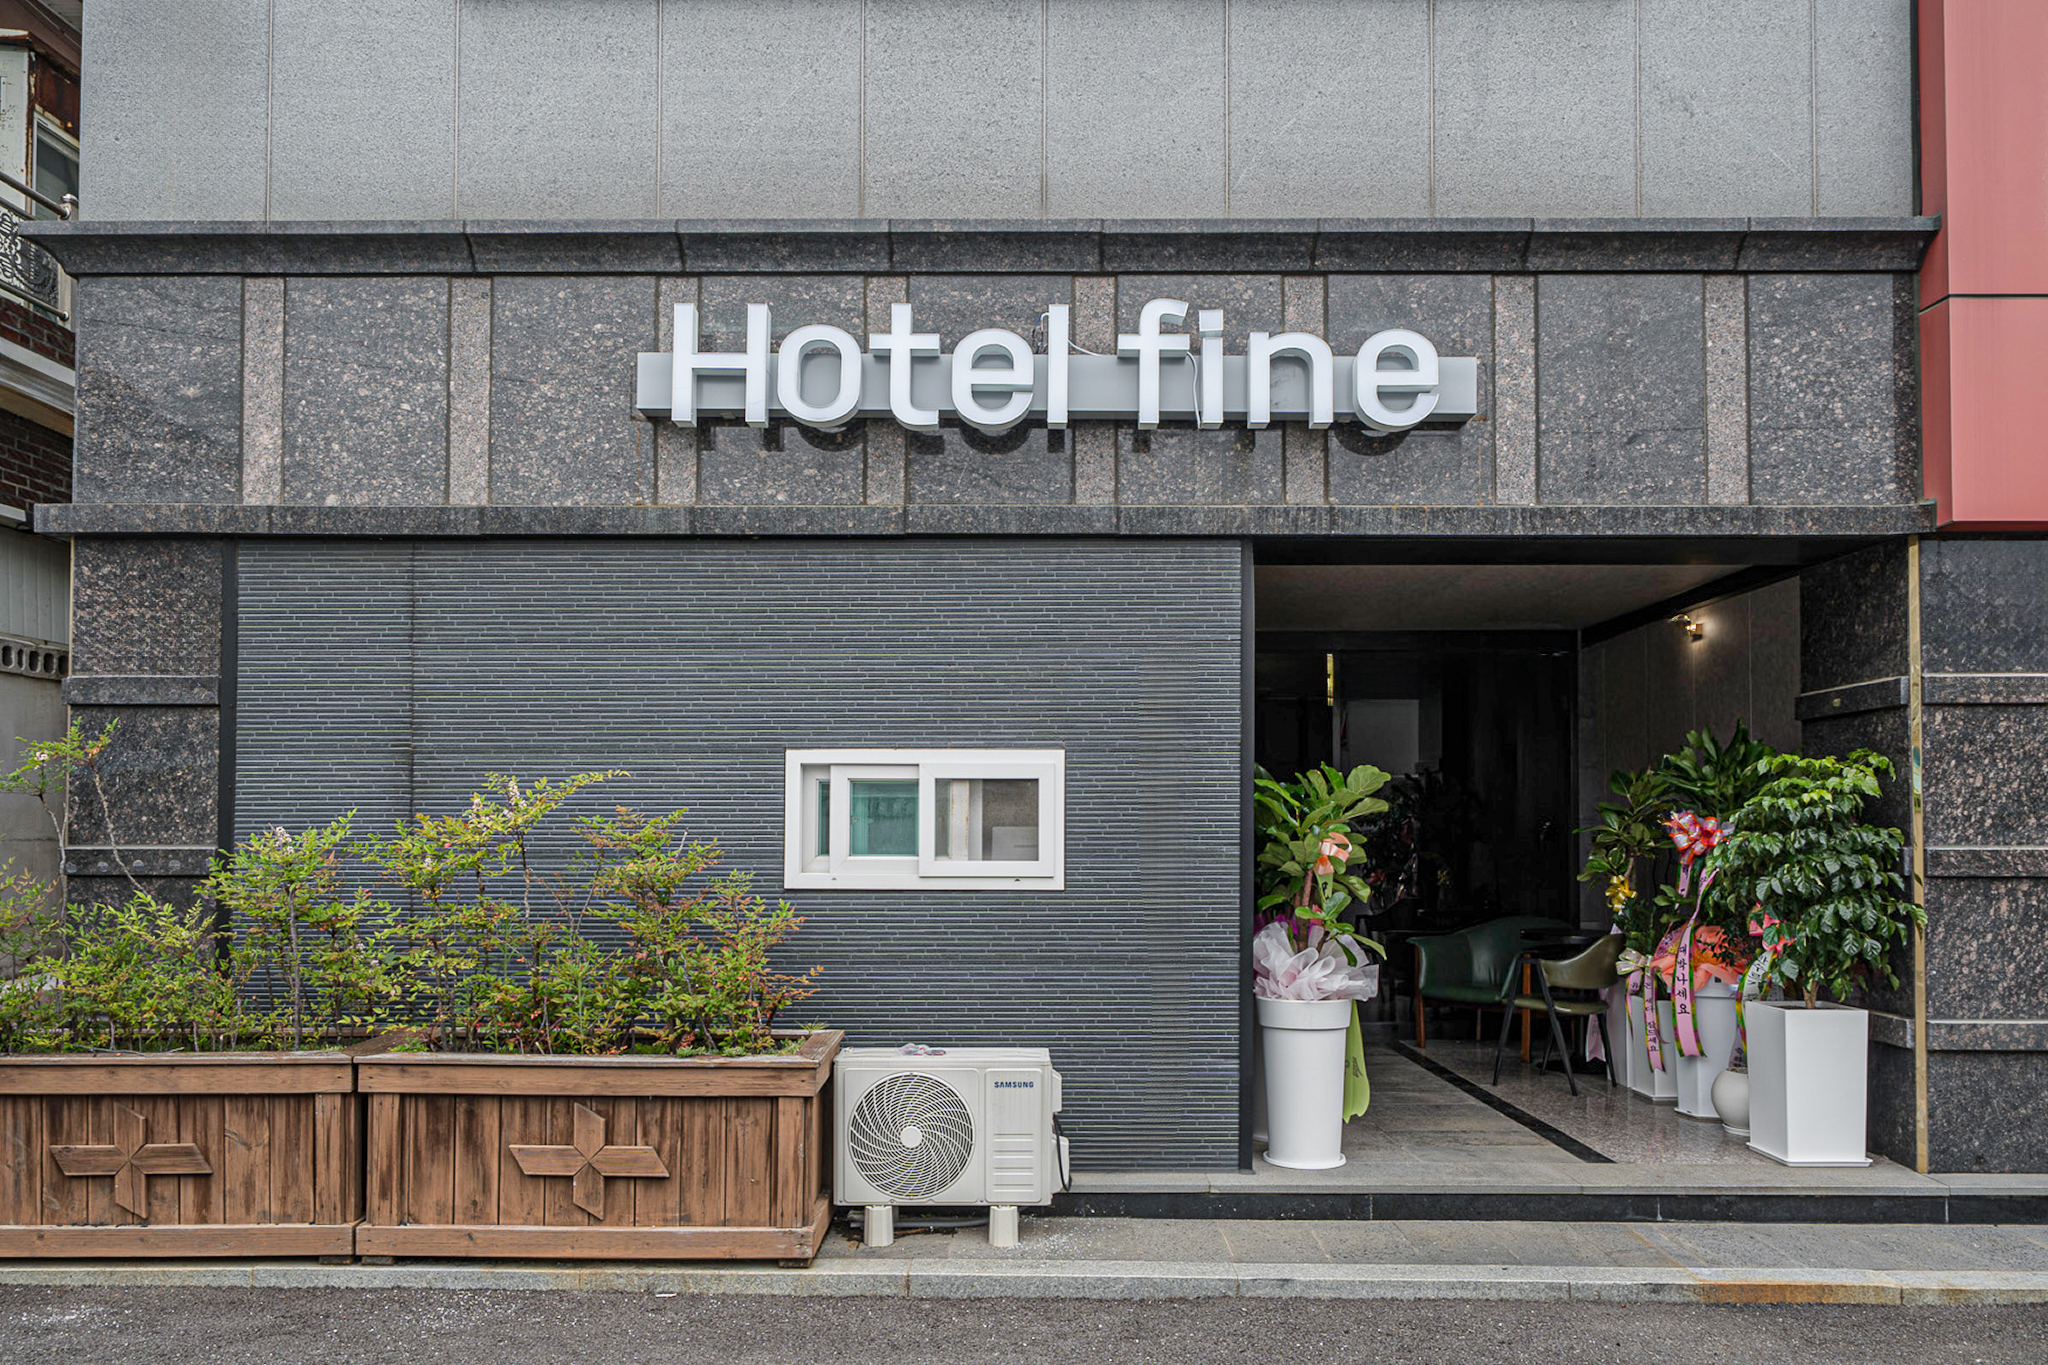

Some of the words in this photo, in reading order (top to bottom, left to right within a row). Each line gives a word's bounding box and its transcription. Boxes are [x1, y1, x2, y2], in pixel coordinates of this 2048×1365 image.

[672, 302, 1070, 430] Hotel
[1117, 298, 1440, 432] fine
[993, 1081, 1035, 1089] SAMSUNG
